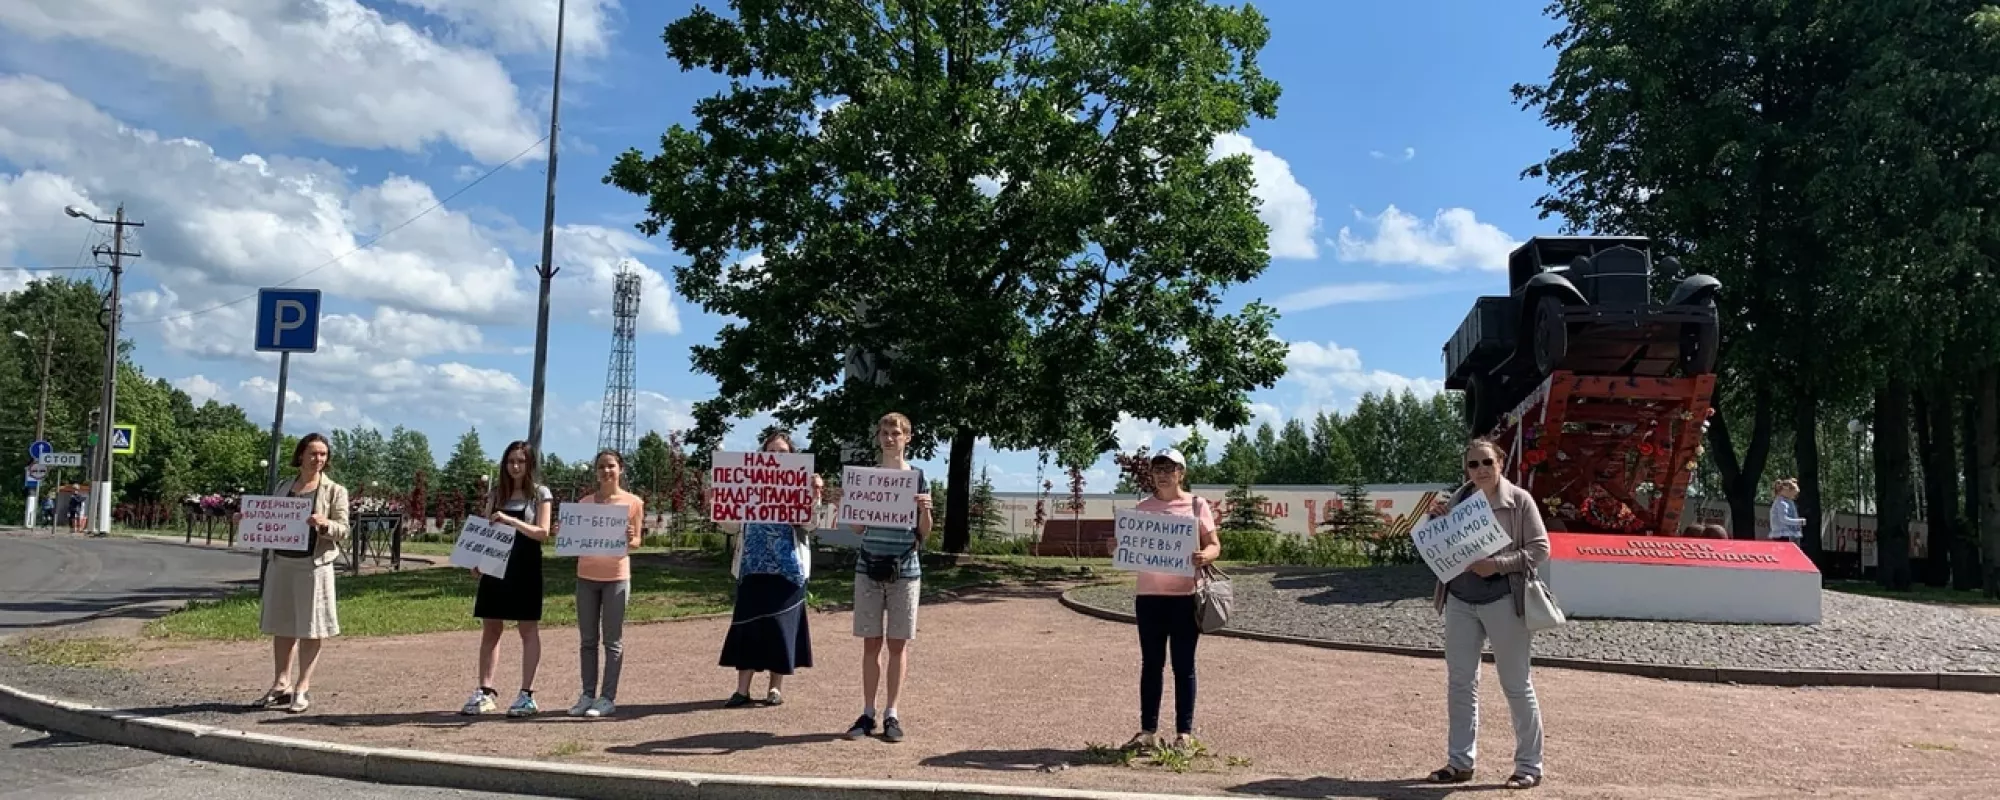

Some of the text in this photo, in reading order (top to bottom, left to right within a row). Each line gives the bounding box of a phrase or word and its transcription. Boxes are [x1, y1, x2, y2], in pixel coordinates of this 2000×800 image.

[273, 300, 307, 346] P
[744, 453, 780, 467] НАД
[714, 467, 807, 486] ПЕСЧАНКОЙ
[847, 472, 913, 488] НЕ ГУБИТЕ
[247, 500, 310, 510] ГУБЕРНАТОР!
[713, 487, 813, 505] НАДРУГАЛИСЬ
[850, 491, 900, 502] КРАСОТУ
[244, 511, 301, 520] ВЫПОЛНИТЕ
[713, 504, 811, 522] ВАС К ОТВЕТУ
[842, 505, 914, 524] ПЕСЧАНКИ!
[1418, 498, 1487, 544] РУКИ ПРОЧЬ
[256, 522, 287, 531] СВОИ
[1119, 517, 1192, 536] СОХРАНИТЕ
[243, 533, 305, 545] ОБЕЩАНИЯ!
[1120, 536, 1181, 551] ДЕРЕВЬЯ
[1426, 515, 1489, 560] ОТ ХОЛМОВ
[1627, 541, 1714, 551] ПАМЯТИ
[1434, 525, 1503, 573] ПЕСЧАНКИ!
[1118, 548, 1189, 570] ПЕСЧАНКИ!
